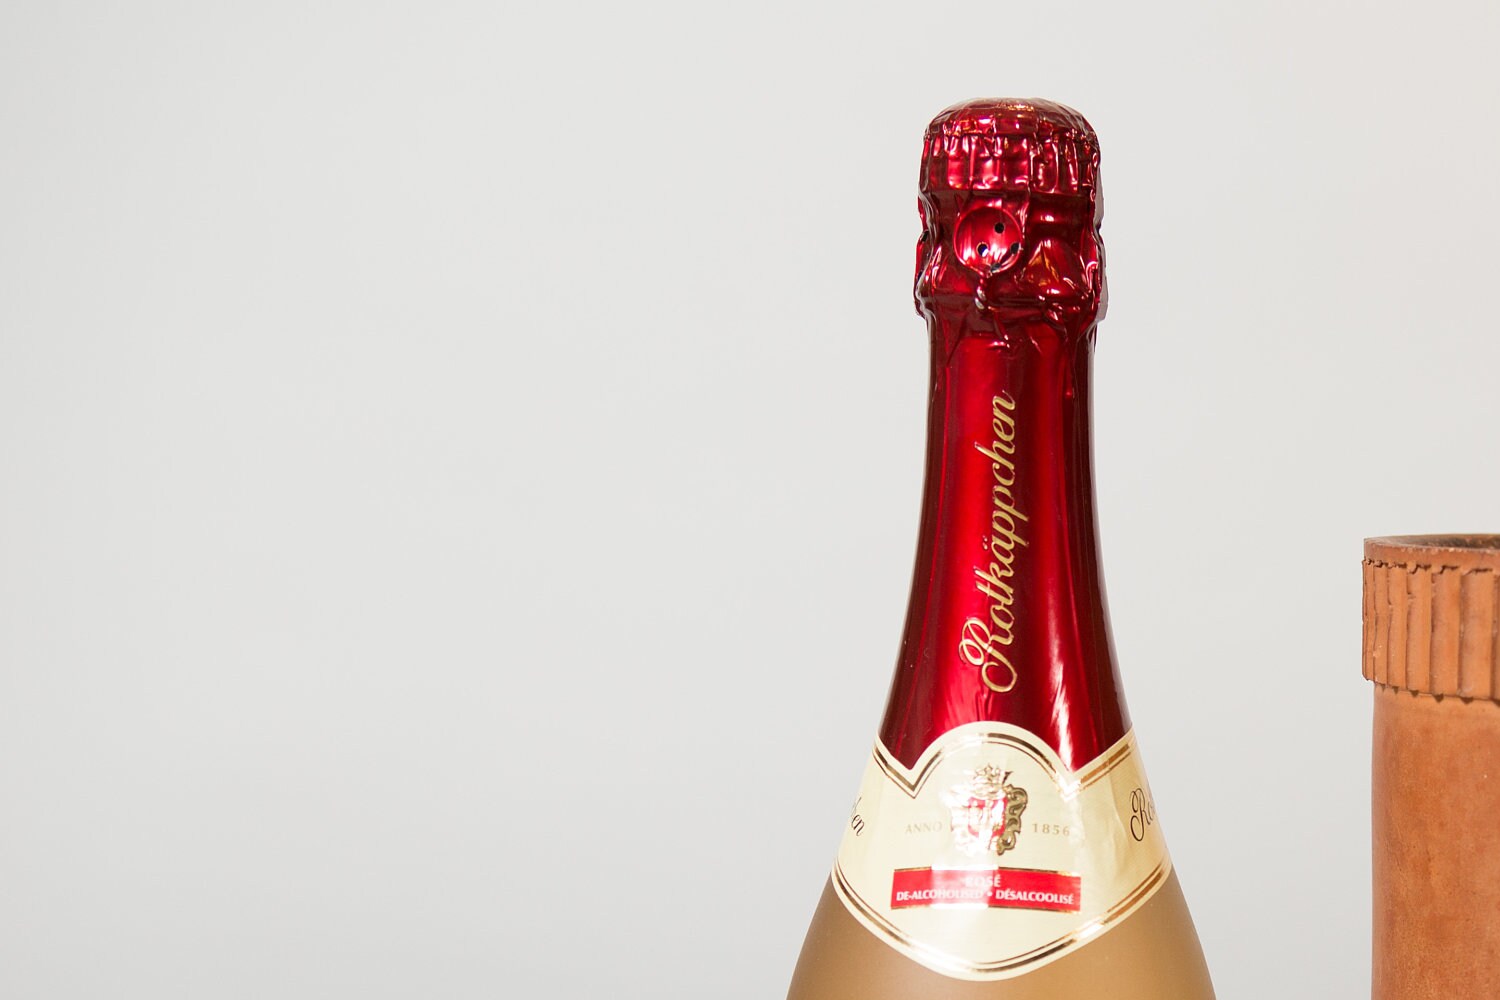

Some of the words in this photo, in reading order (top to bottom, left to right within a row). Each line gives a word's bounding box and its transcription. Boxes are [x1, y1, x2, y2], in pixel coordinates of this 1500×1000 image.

[958, 389, 1030, 693] Rotkäppchen
[905, 821, 943, 835] ANNO
[1032, 822, 1071, 837] 1856
[965, 874, 1002, 888] ROSÉ
[896, 888, 984, 901] DE-ALCOHOLISED
[995, 888, 1075, 905] DÉSALCOOLISÉ
